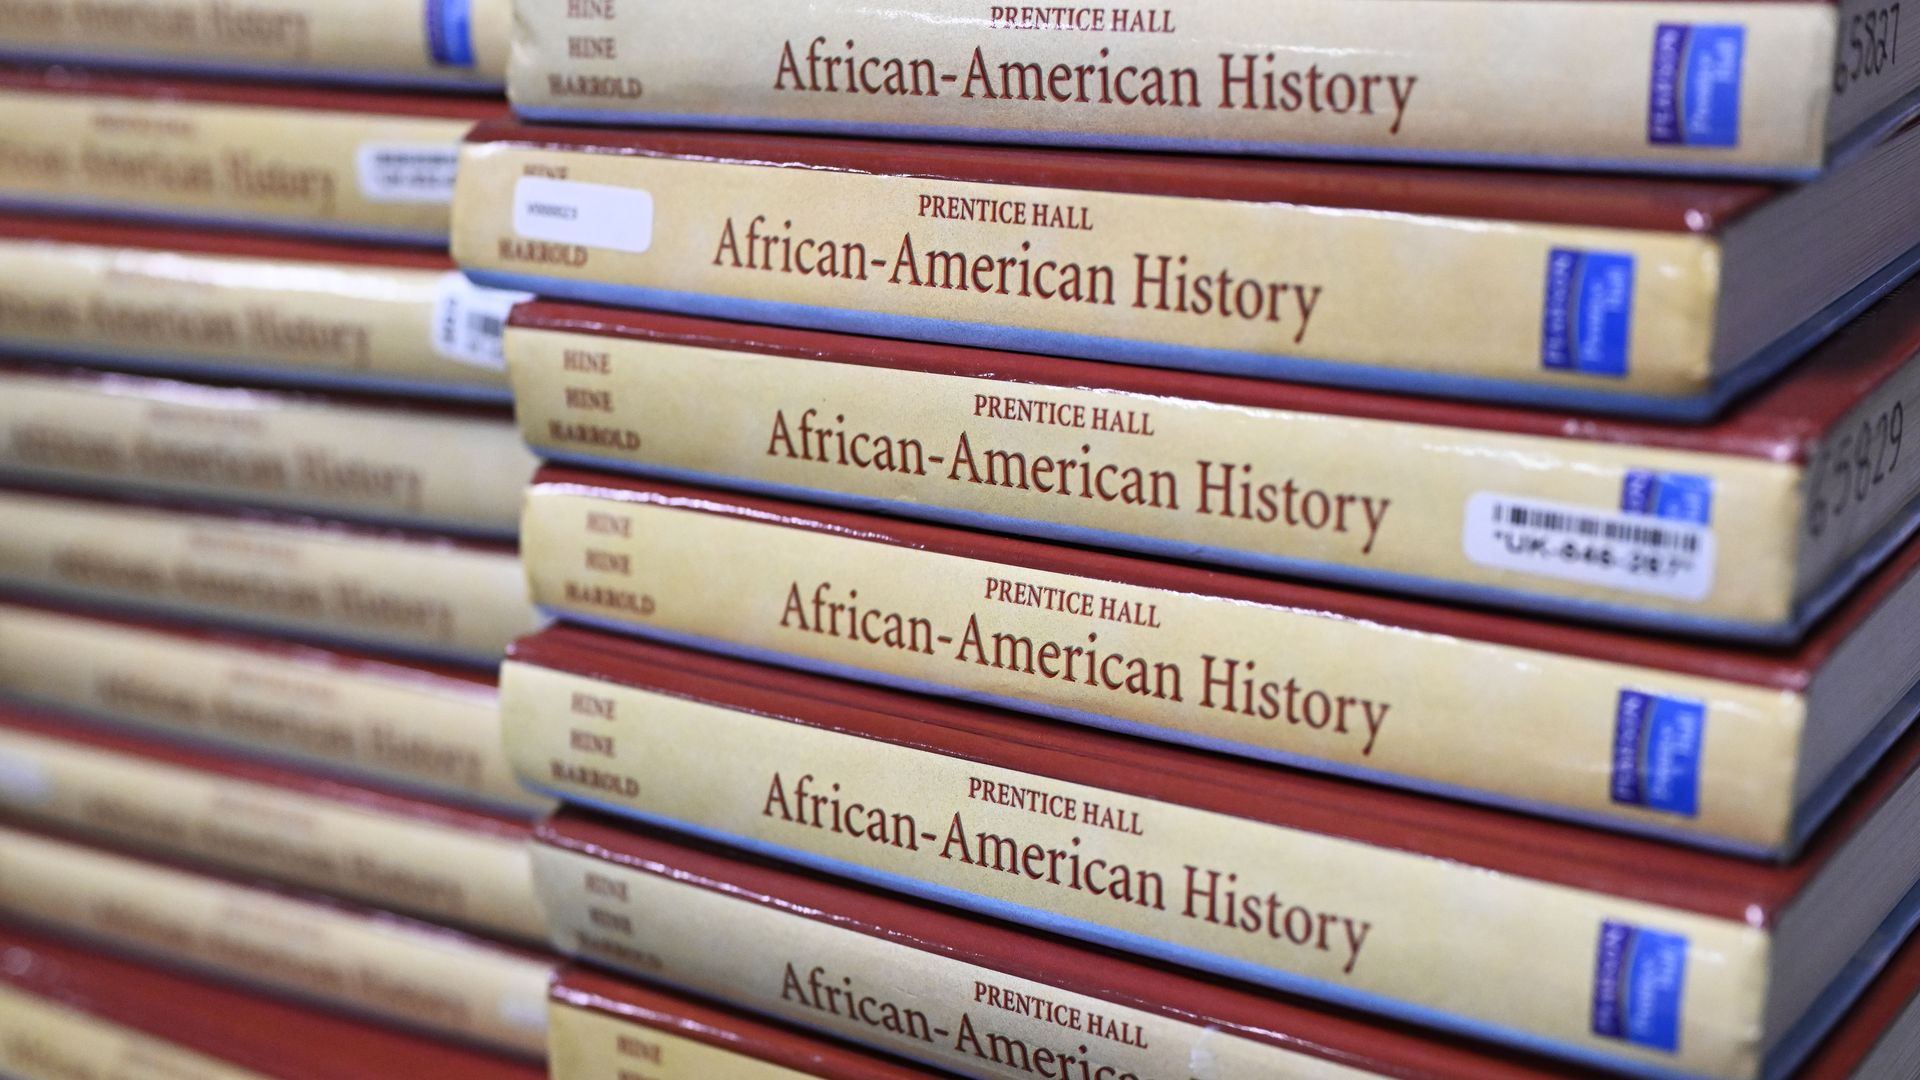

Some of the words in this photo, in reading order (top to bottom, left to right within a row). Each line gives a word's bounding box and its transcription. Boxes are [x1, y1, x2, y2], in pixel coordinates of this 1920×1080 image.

[991, 6, 1104, 32] PRENTICE
[1109, 9, 1176, 33] HALL
[567, 36, 617, 60] HINE
[548, 73, 644, 100] HARROLD
[773, 36, 1200, 109] African-American
[1218, 53, 1418, 134] History
[918, 194, 1026, 226] PRENTICE
[1032, 204, 1093, 231] HALL
[712, 215, 1115, 306] African-American
[1132, 253, 1323, 343] History
[563, 349, 612, 375] HINE
[565, 387, 614, 412] HINE
[974, 393, 1086, 429] PRENTICE
[1091, 403, 1155, 437] HALL
[548, 421, 641, 452] HARROLD
[766, 407, 1180, 511] African-American
[1196, 460, 1392, 555] History
[585, 511, 632, 538] HINE
[585, 549, 631, 575] HINE
[984, 576, 1095, 618] PRENTICE
[1098, 595, 1162, 630] HALL
[780, 580, 1183, 704] African-American
[1198, 653, 1391, 757] History
[968, 776, 1078, 822] PRENTICE
[1082, 801, 1145, 837] HALL
[762, 771, 1167, 911] African-American
[1180, 863, 1372, 975] History
[781, 961, 1142, 1080] African-Ameri
[974, 980, 1082, 1032] PRENTICE
[1086, 1012, 1149, 1050] HALL
